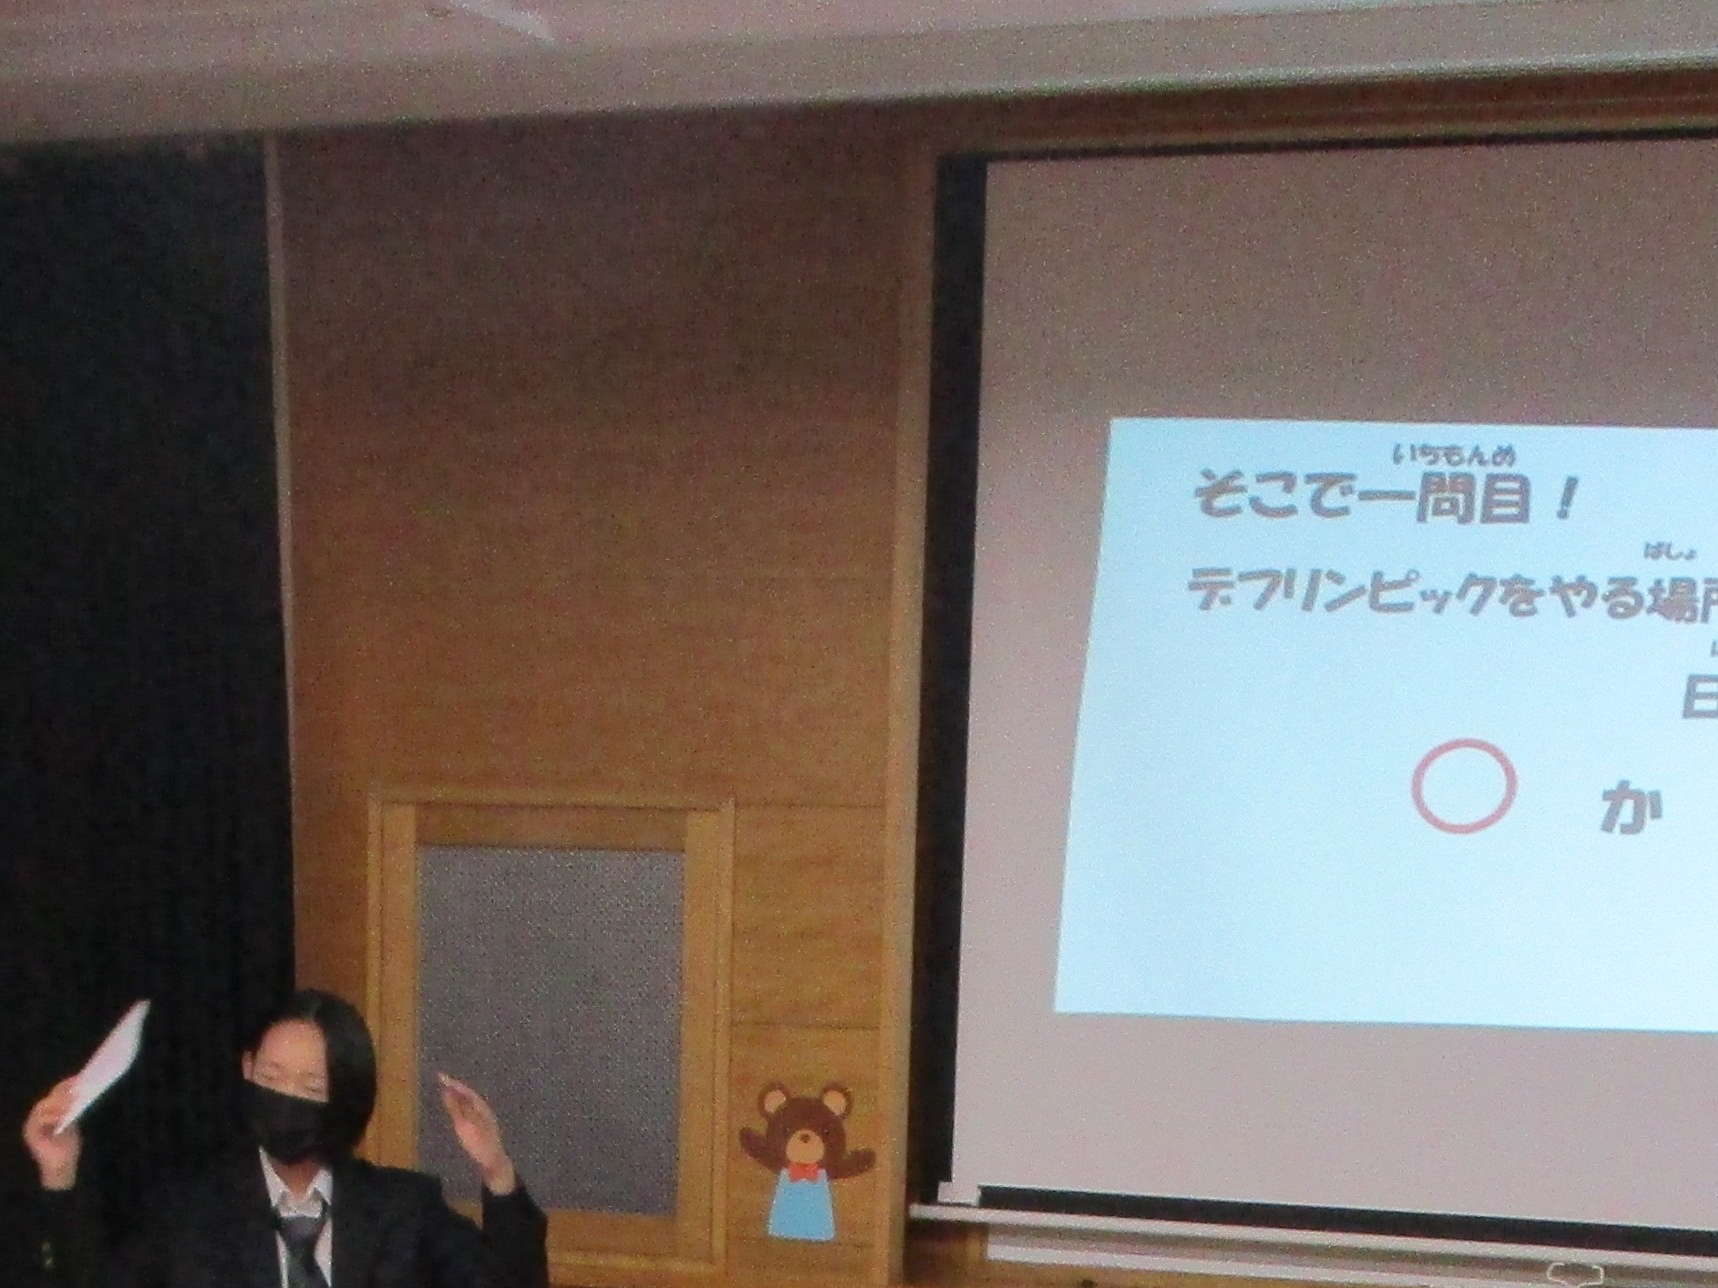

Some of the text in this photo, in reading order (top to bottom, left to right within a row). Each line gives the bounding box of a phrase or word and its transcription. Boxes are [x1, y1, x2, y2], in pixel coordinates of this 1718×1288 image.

[1392, 442, 1518, 468] いちもんめ
[1642, 540, 1698, 561] ばしょ
